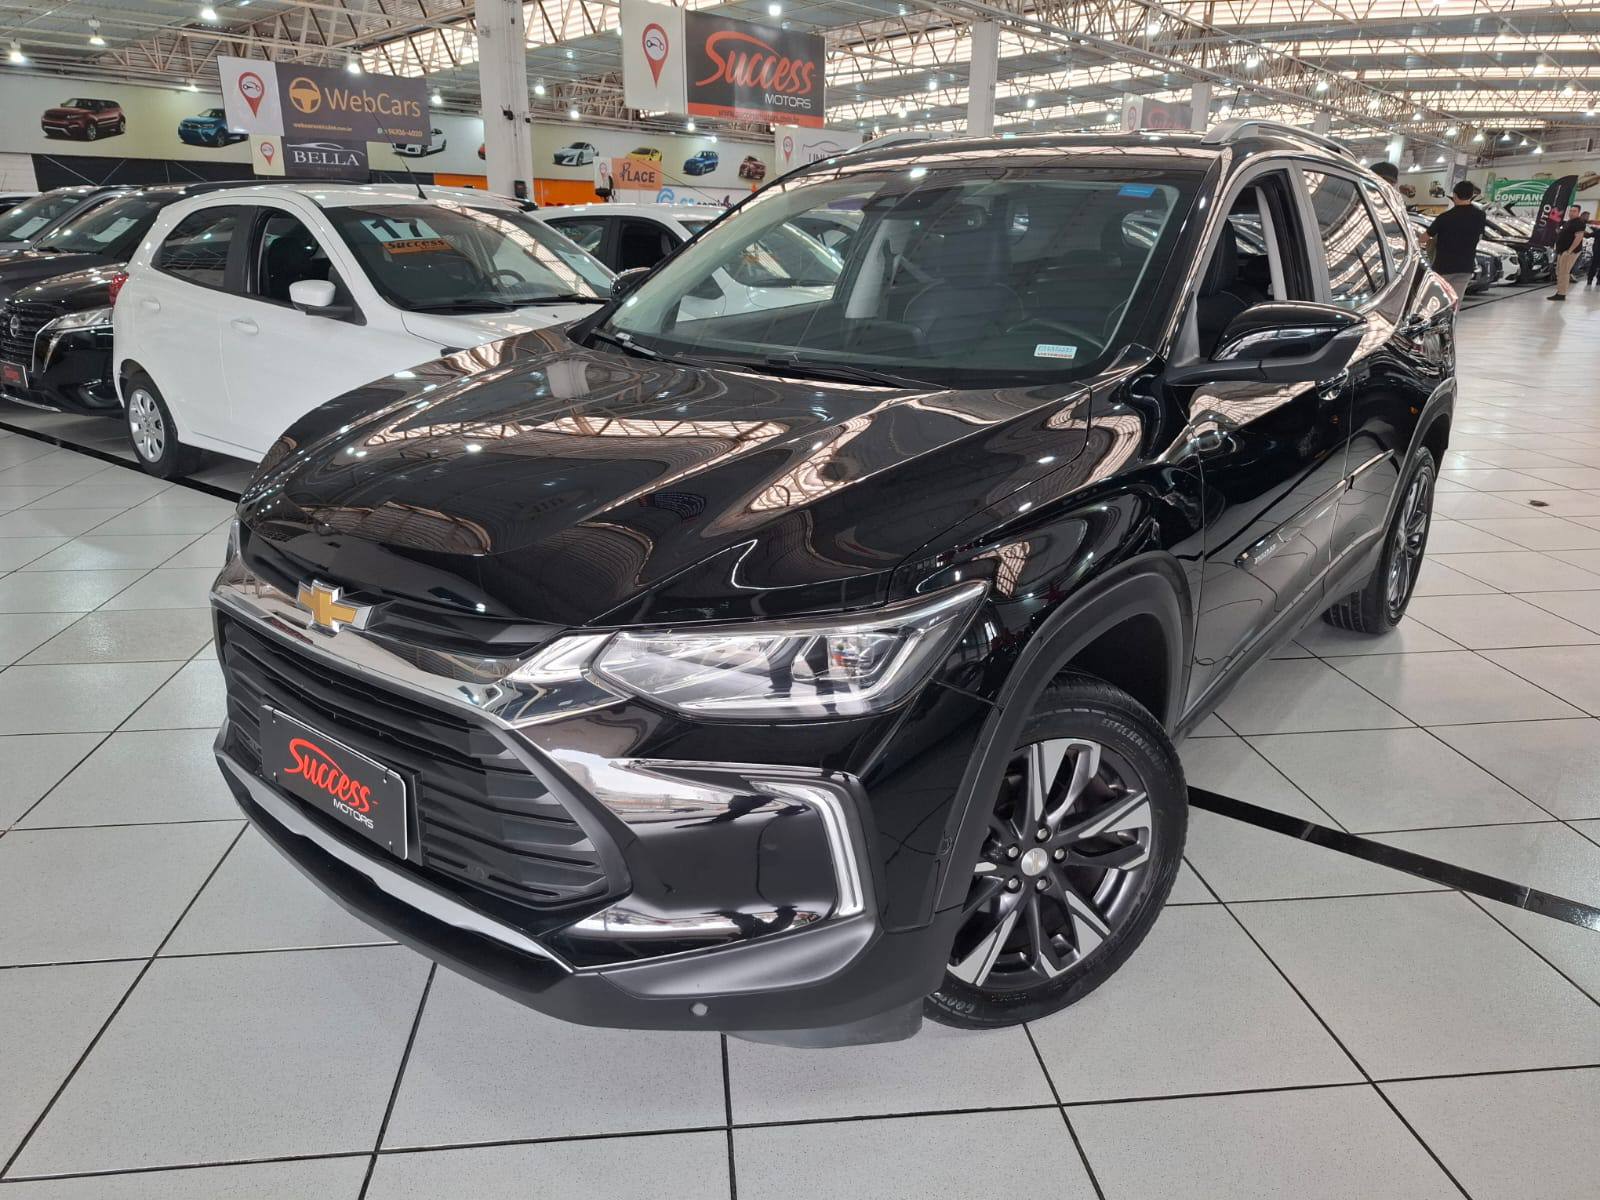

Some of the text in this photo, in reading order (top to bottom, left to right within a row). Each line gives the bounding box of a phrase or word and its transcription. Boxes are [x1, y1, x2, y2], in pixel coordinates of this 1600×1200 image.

[696, 31, 816, 94] Success
[324, 87, 421, 118] WebCars
[764, 93, 812, 109] MOTORS
[293, 150, 360, 166] BELLA
[619, 161, 656, 183] PLACE
[284, 738, 371, 813] Success
[333, 798, 375, 829] MOTORS
